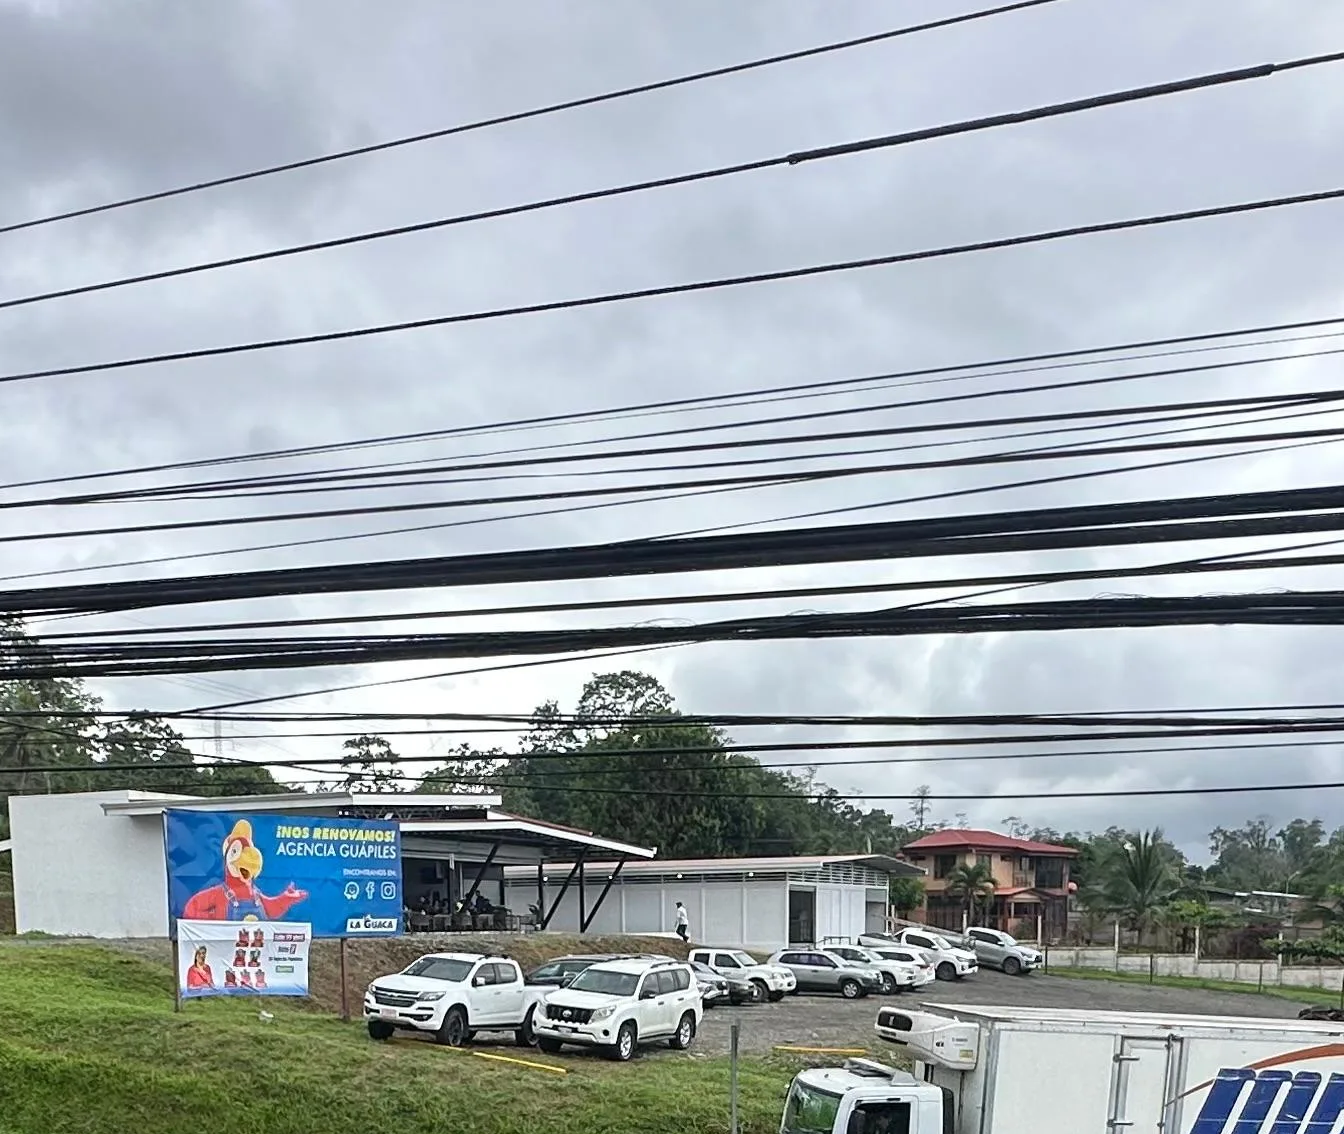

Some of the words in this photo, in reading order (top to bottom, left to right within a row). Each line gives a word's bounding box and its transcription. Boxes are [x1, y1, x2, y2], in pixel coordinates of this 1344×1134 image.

[312, 827, 396, 842] RENOVAMOS!
[275, 842, 336, 857] AGENCIA
[339, 841, 397, 859] GUÁPILES
